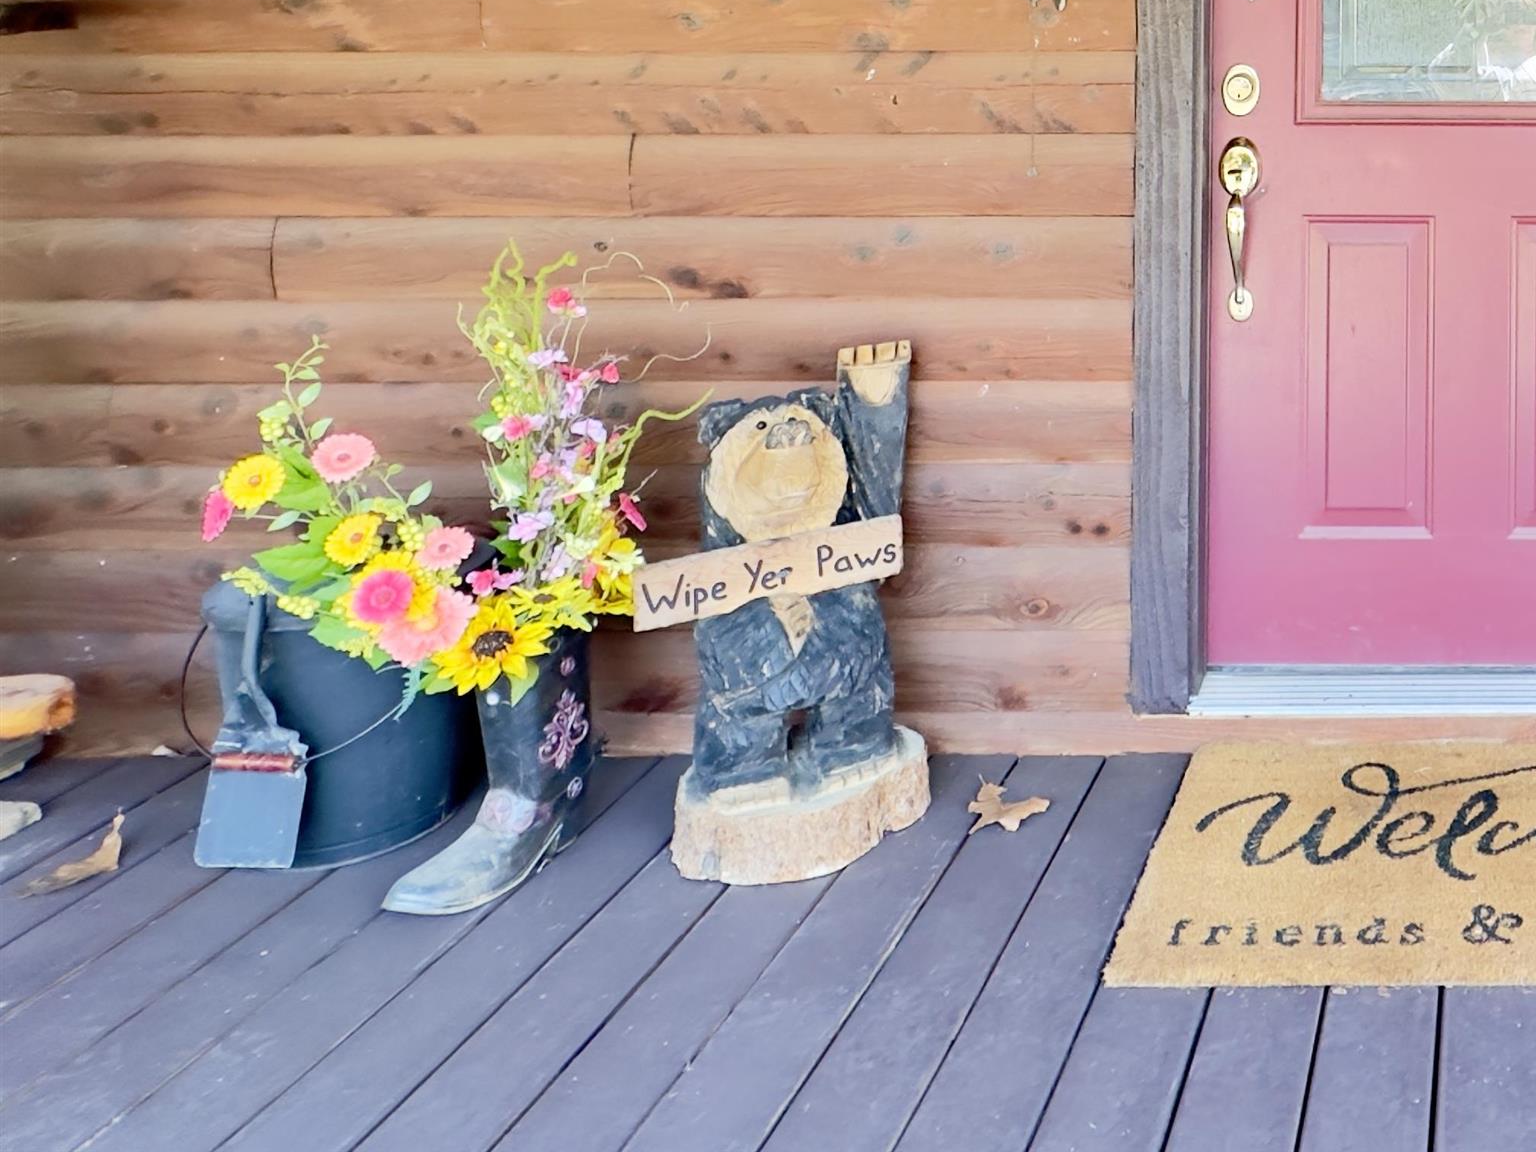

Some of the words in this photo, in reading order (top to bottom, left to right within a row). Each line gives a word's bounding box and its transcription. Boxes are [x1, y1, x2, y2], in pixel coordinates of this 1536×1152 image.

[641, 573, 727, 614] Wipe
[743, 559, 793, 593] Yer
[816, 542, 897, 577] Paws
[1166, 914, 1425, 947] friends
[1461, 903, 1523, 945] &
